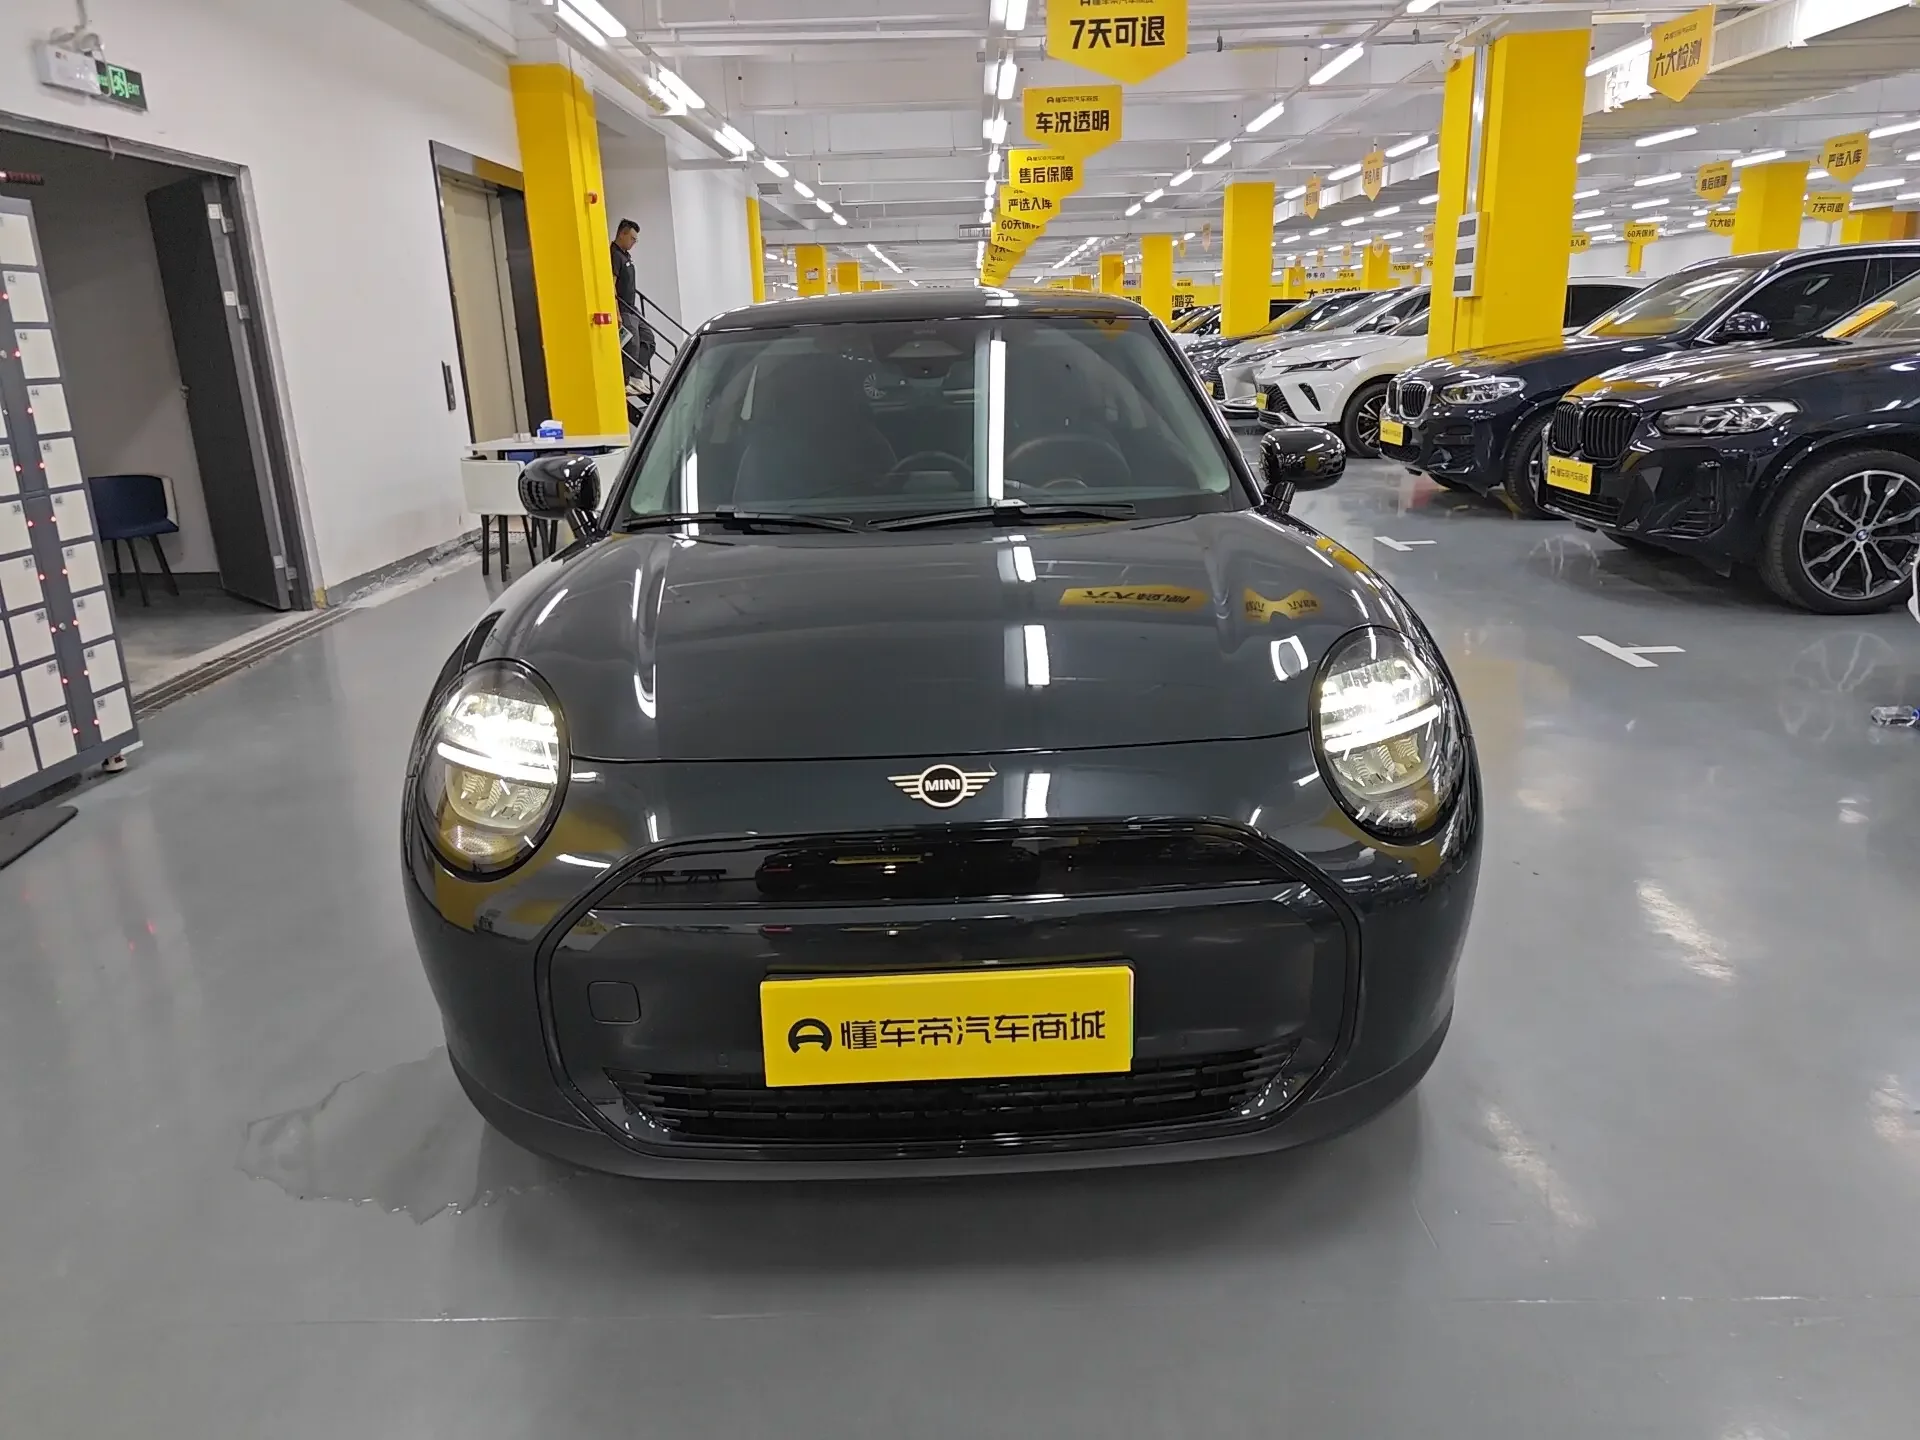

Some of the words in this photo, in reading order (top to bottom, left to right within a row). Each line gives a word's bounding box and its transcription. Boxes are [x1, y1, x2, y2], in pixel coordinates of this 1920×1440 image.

[1069, 15, 1165, 49] 7天可退
[1653, 37, 1702, 79] 六大检测
[1035, 109, 1110, 133] 车况透明
[1827, 148, 1863, 169] 严选入库
[1018, 165, 1074, 184] 售后保障
[1008, 197, 1053, 212] 严选入库
[925, 778, 961, 792] MINI
[839, 1009, 1106, 1051] 懂车帝汽车商城
